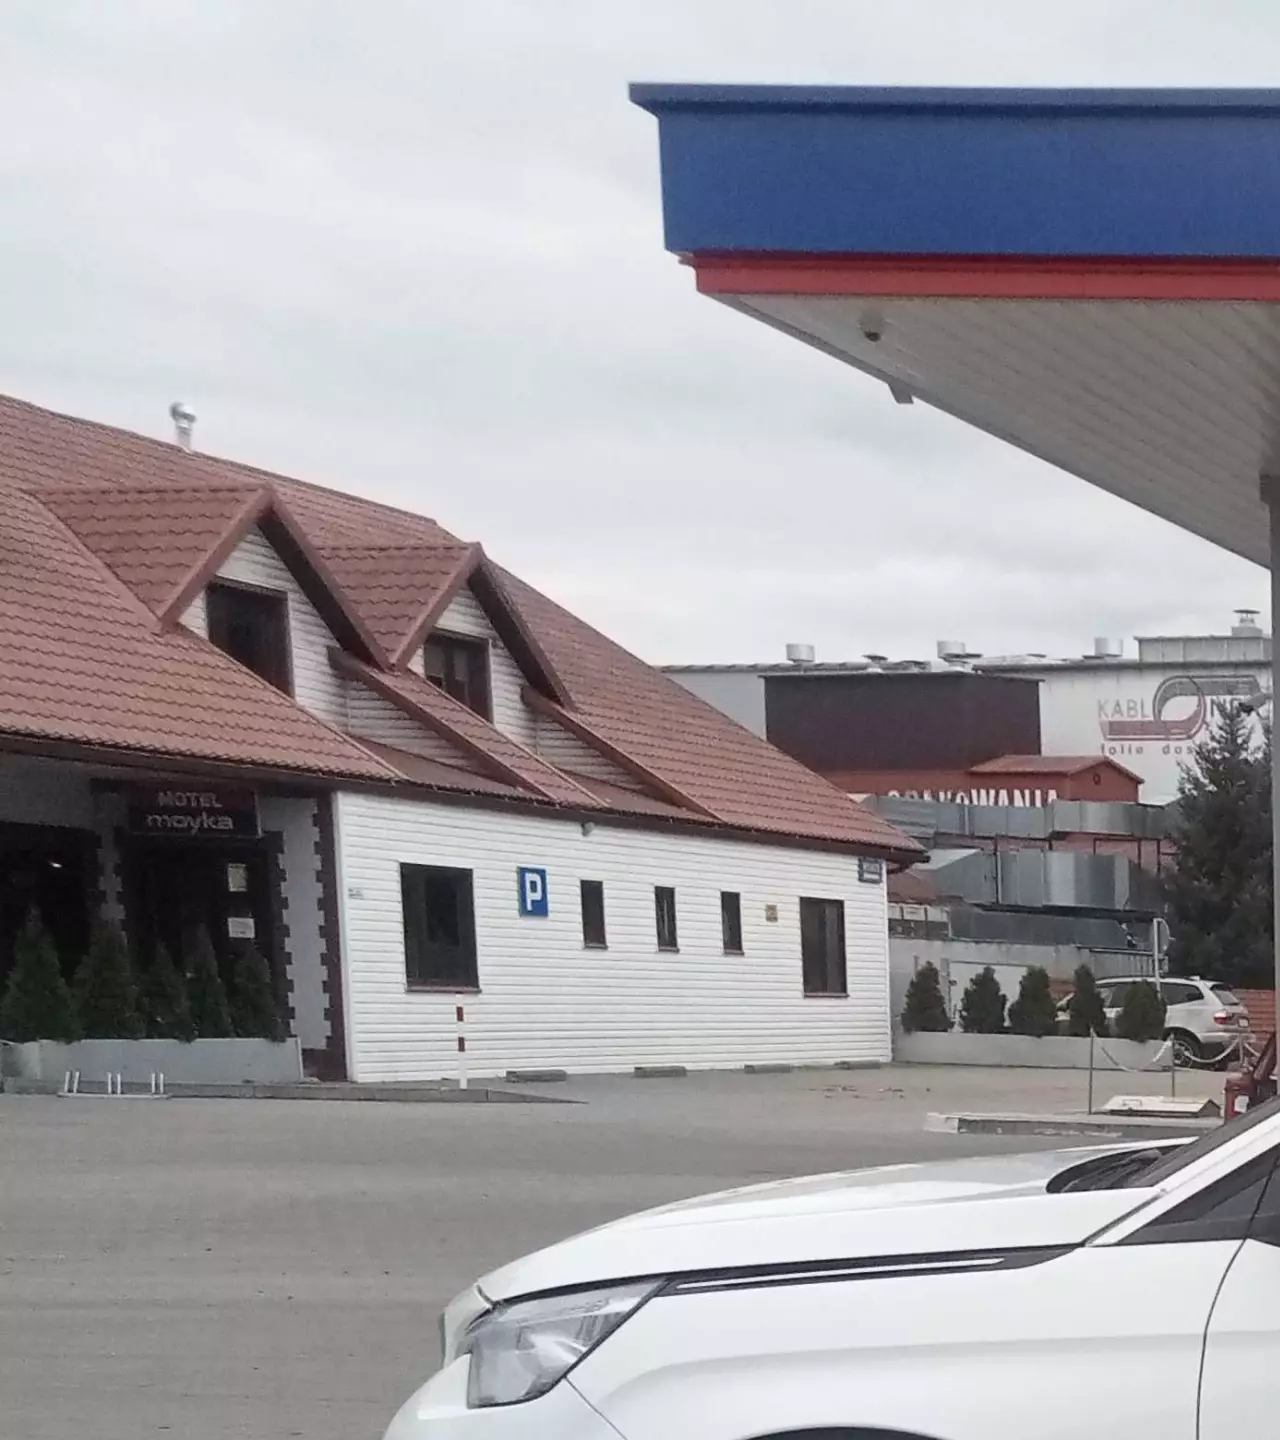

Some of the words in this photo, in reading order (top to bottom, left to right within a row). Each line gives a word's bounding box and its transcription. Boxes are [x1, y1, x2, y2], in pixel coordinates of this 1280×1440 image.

[157, 790, 223, 808] MOTEL
[147, 811, 234, 835] moyka
[524, 872, 543, 911] P
